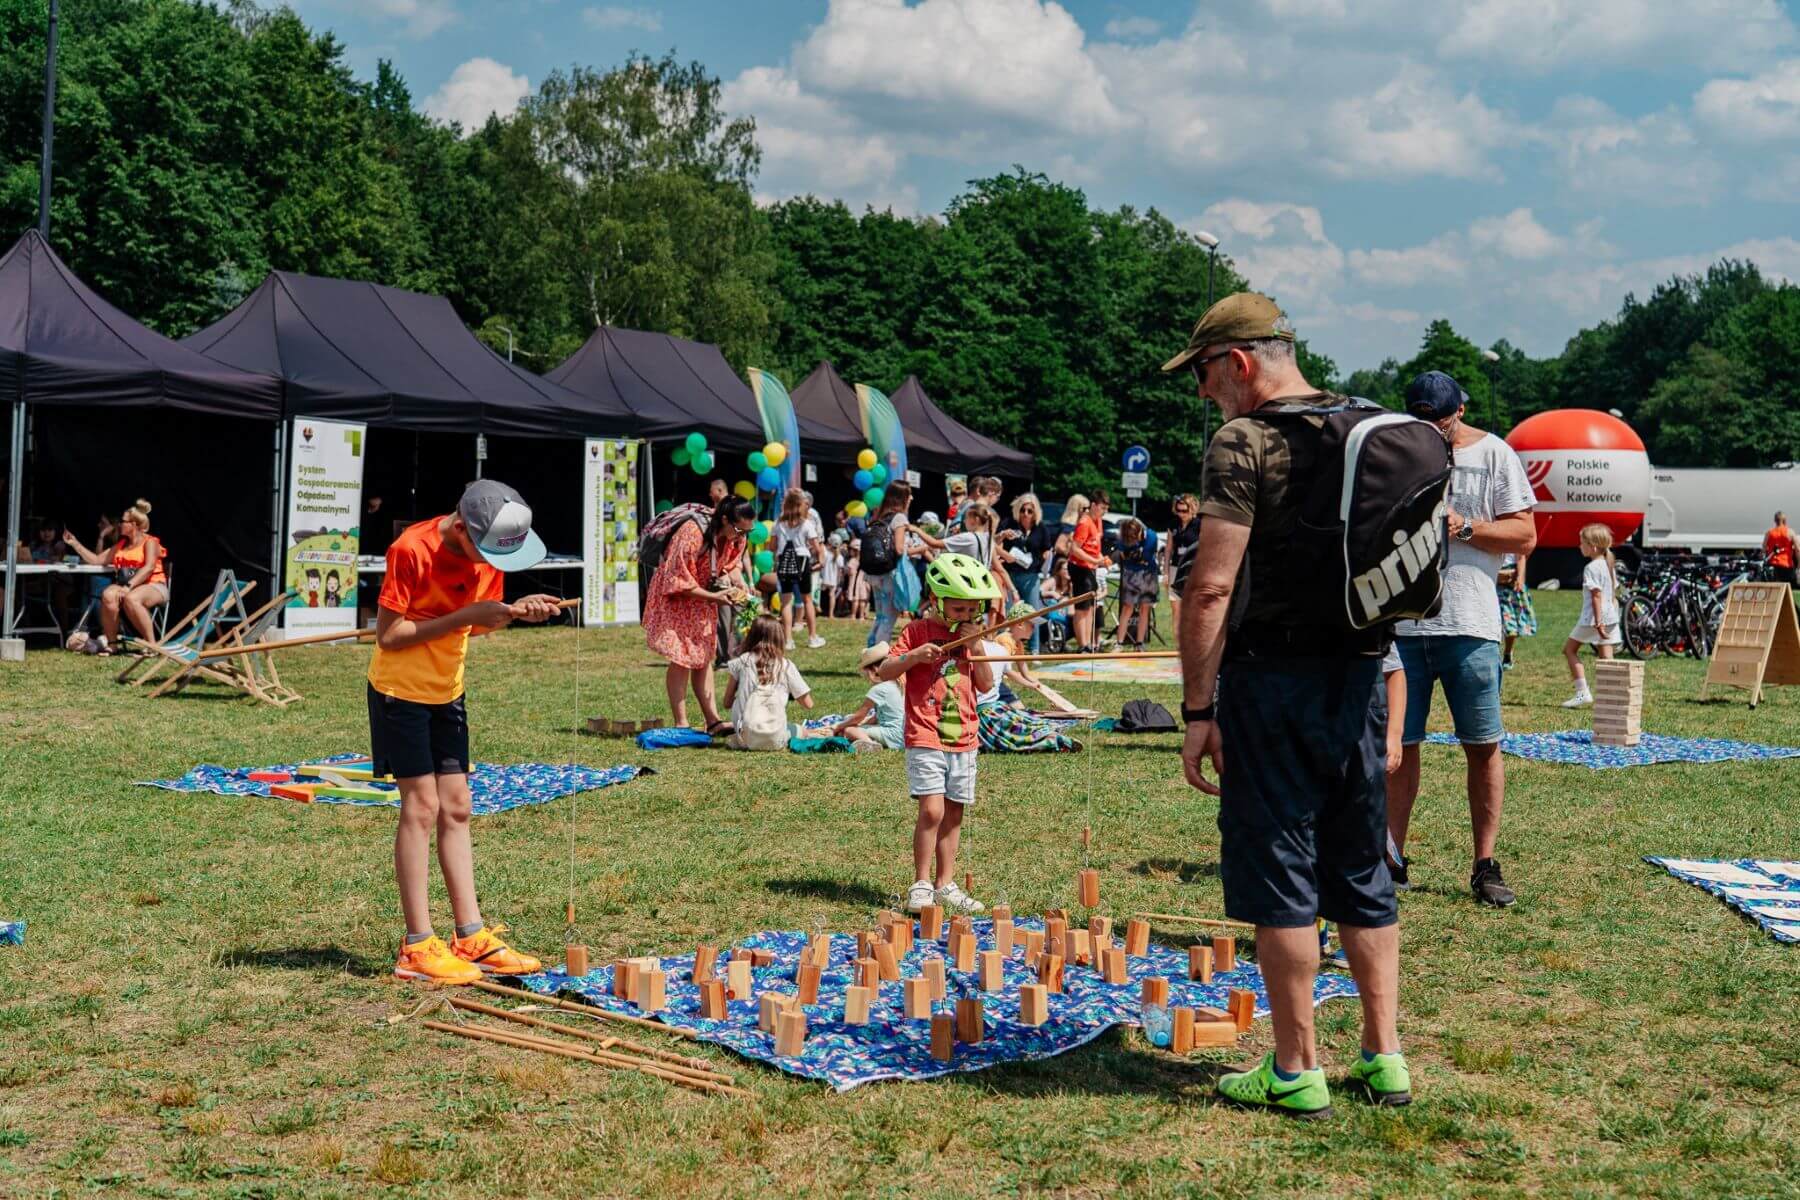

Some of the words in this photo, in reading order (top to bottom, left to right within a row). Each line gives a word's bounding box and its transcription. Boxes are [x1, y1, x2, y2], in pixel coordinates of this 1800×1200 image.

[298, 464, 326, 475] System
[1567, 459, 1610, 471] Polskie
[1567, 474, 1603, 486] Radio
[297, 490, 336, 503] Odpadami
[1567, 491, 1622, 503] Katowice
[296, 504, 350, 517] Komunalnymi
